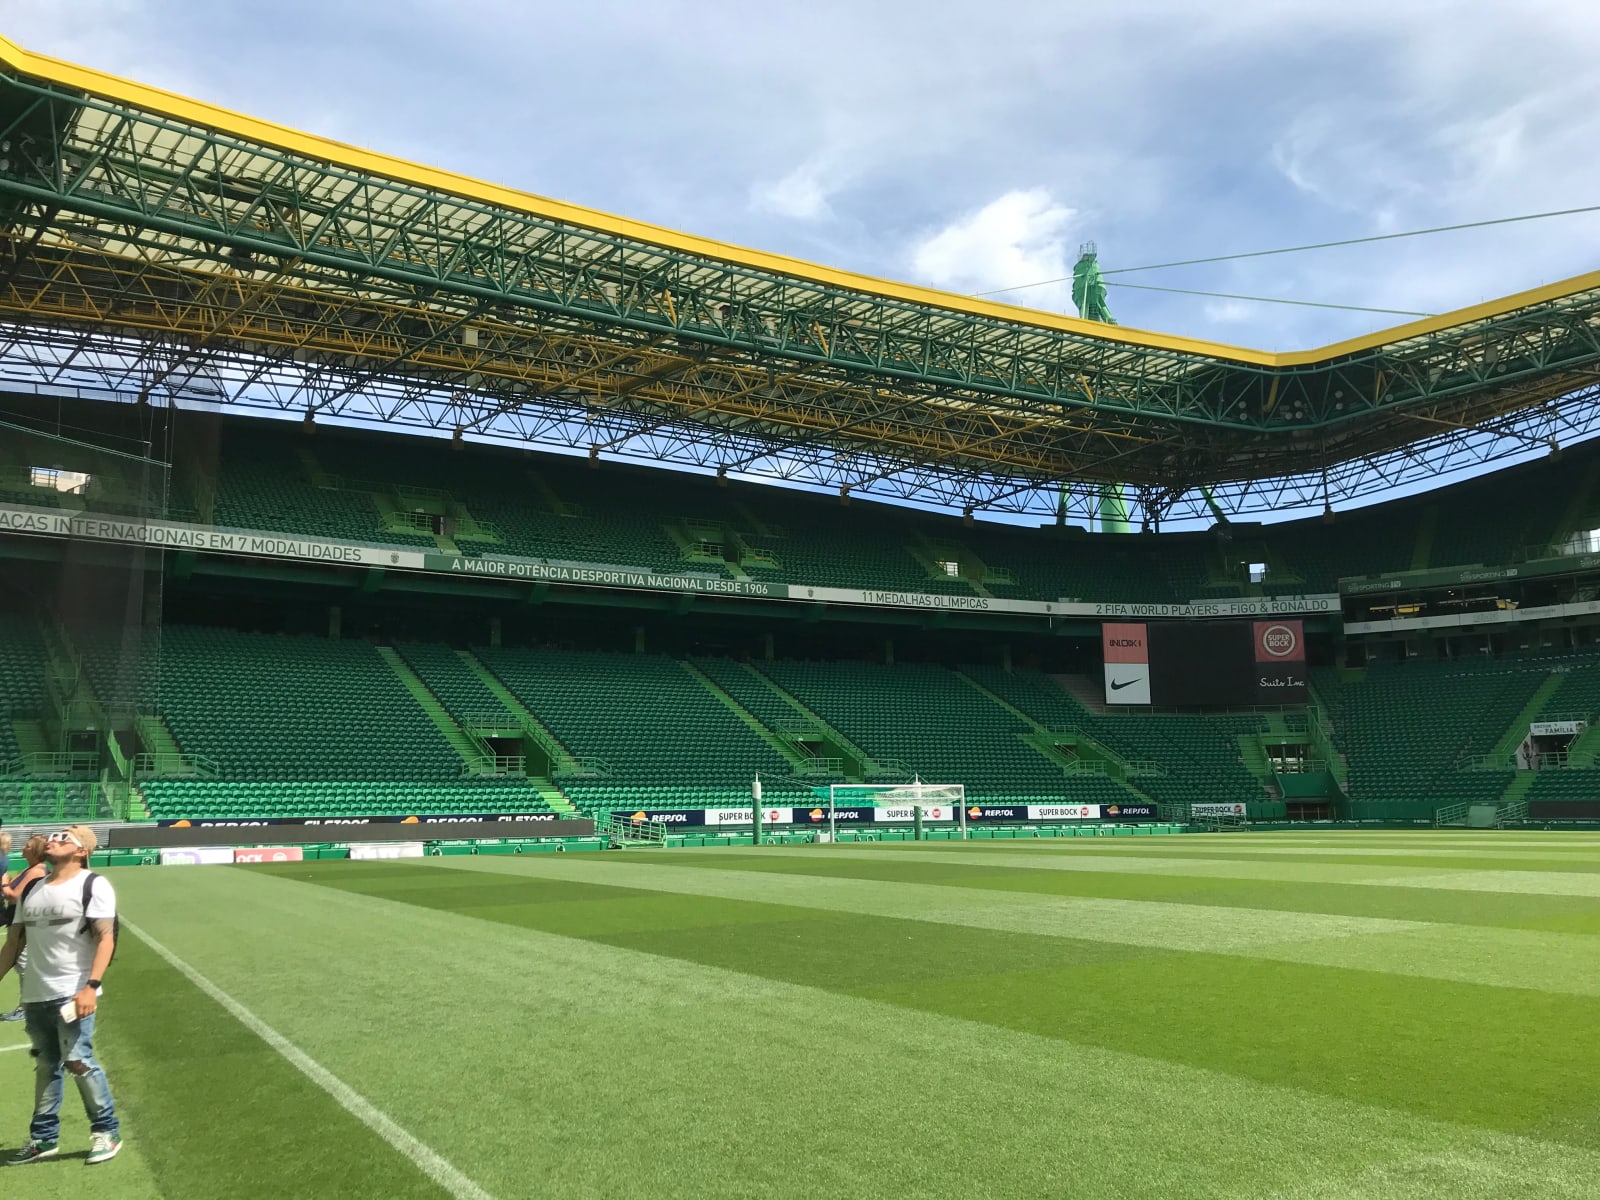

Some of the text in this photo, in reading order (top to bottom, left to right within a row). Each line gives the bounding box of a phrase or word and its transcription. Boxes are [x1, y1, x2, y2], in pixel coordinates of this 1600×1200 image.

[54, 518, 205, 546] INTERNACIONAIS
[209, 534, 234, 549] EM
[238, 537, 248, 550] 7
[251, 538, 362, 562] MODALIDADES
[452, 559, 768, 594] A MAIOR POTÊNCIA DESPORTIVA NACIONAL DESDE 1906
[862, 591, 989, 609] 11 MEDALHAS OLÍMPICAS
[1096, 604, 1102, 614] 2
[1105, 604, 1127, 615] FIFA
[1132, 604, 1169, 615] WORLD
[1171, 604, 1219, 616] PLAYERS
[1230, 603, 1256, 614] FIGO
[1260, 602, 1268, 613] &
[1272, 600, 1329, 613] RONALDO
[886, 809, 909, 818] SUPER
[984, 809, 1014, 817] REPSOL
[1039, 808, 1059, 816] SUPER
[1122, 807, 1150, 815] REPSOL
[651, 814, 688, 822] REPSOL
[719, 812, 743, 821] SUPER
[24, 905, 65, 917] GUCCI
